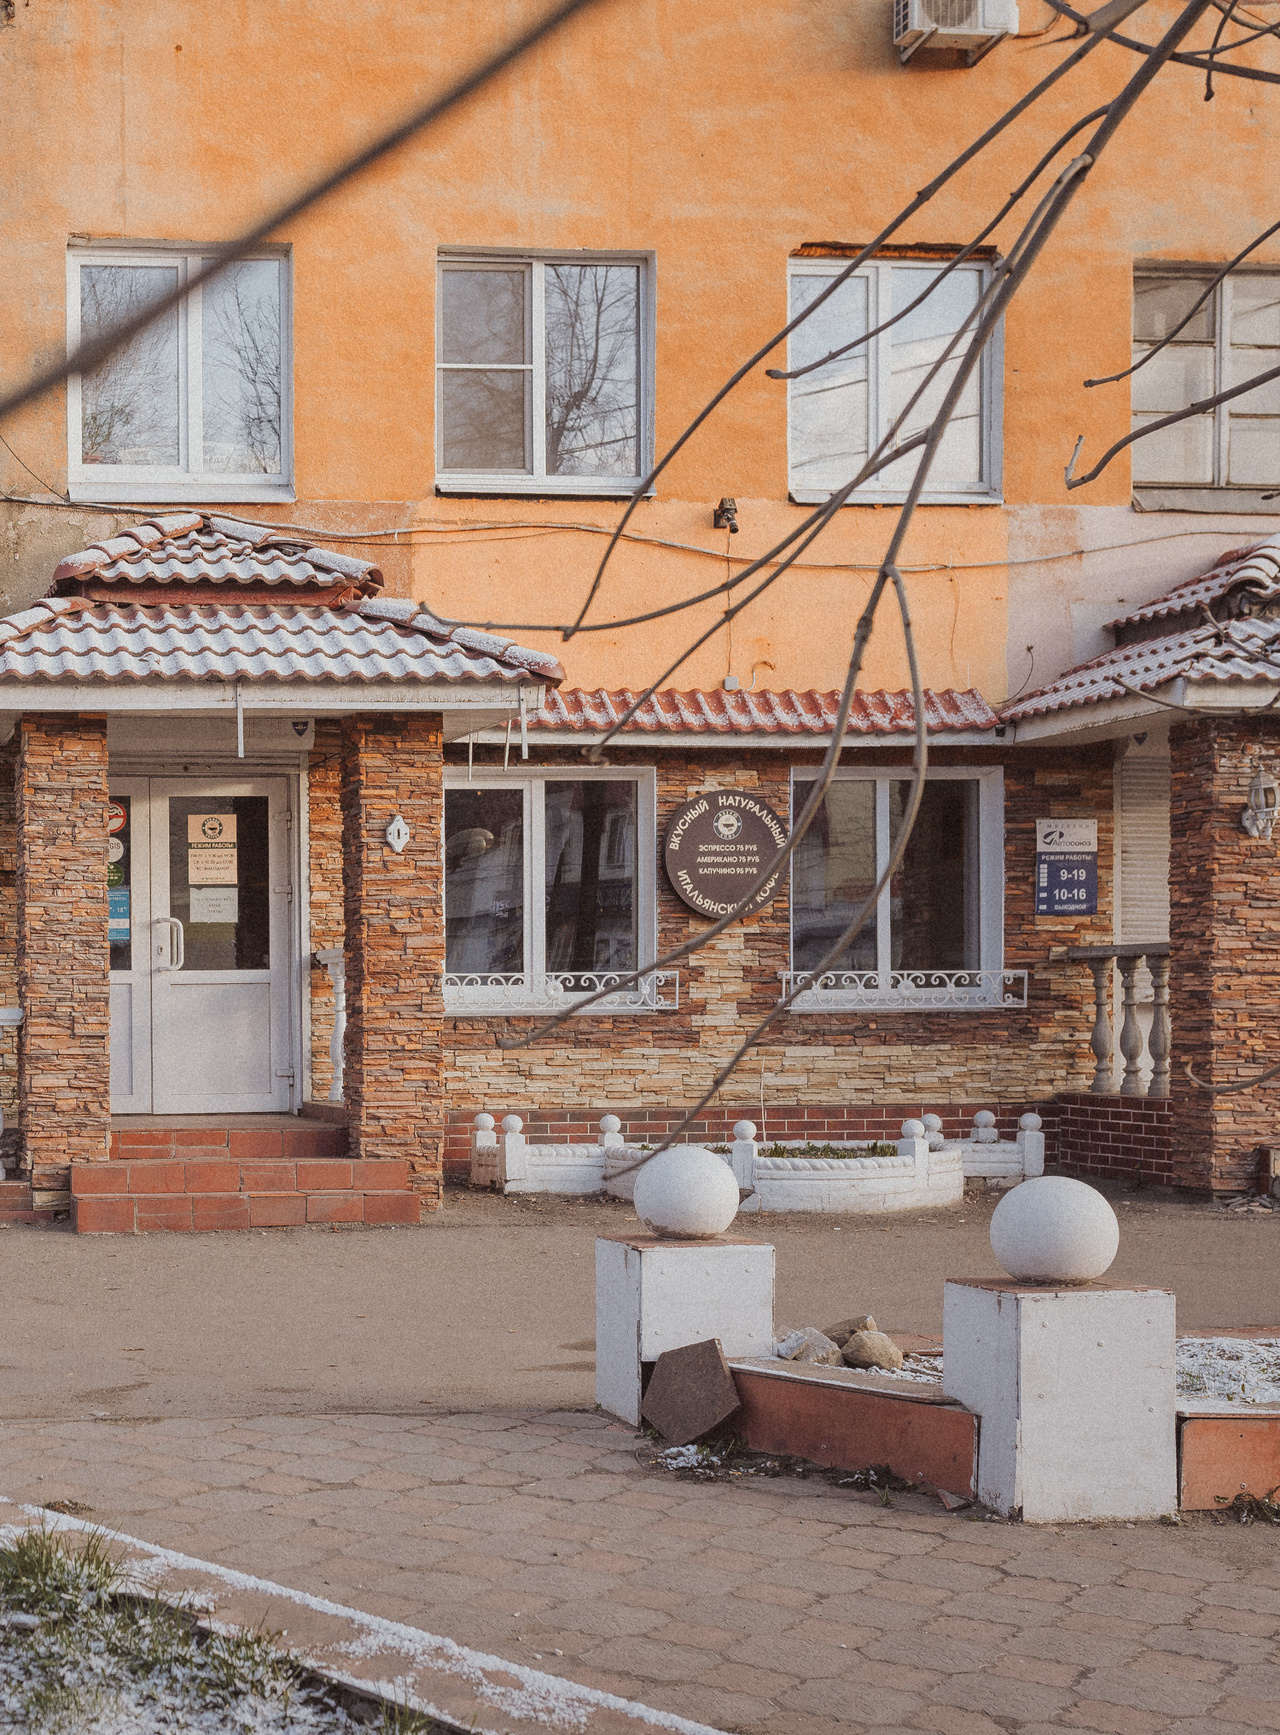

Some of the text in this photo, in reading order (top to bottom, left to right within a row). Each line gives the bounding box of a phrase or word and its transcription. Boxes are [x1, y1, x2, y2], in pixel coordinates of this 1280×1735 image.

[669, 795, 788, 851] ВКУСНЫЙ НАТУРАЛЬНЫЙ
[1051, 839, 1092, 847] Автосоюз
[698, 844, 758, 852] ЭСПРЕССО 75 РУБ
[698, 867, 758, 875] КАПУЧИНО 95 РУБ
[1060, 868, 1087, 881] 9-19
[1053, 888, 1087, 900] 10-16
[1054, 903, 1087, 911] ВЫХОДНОЙ
